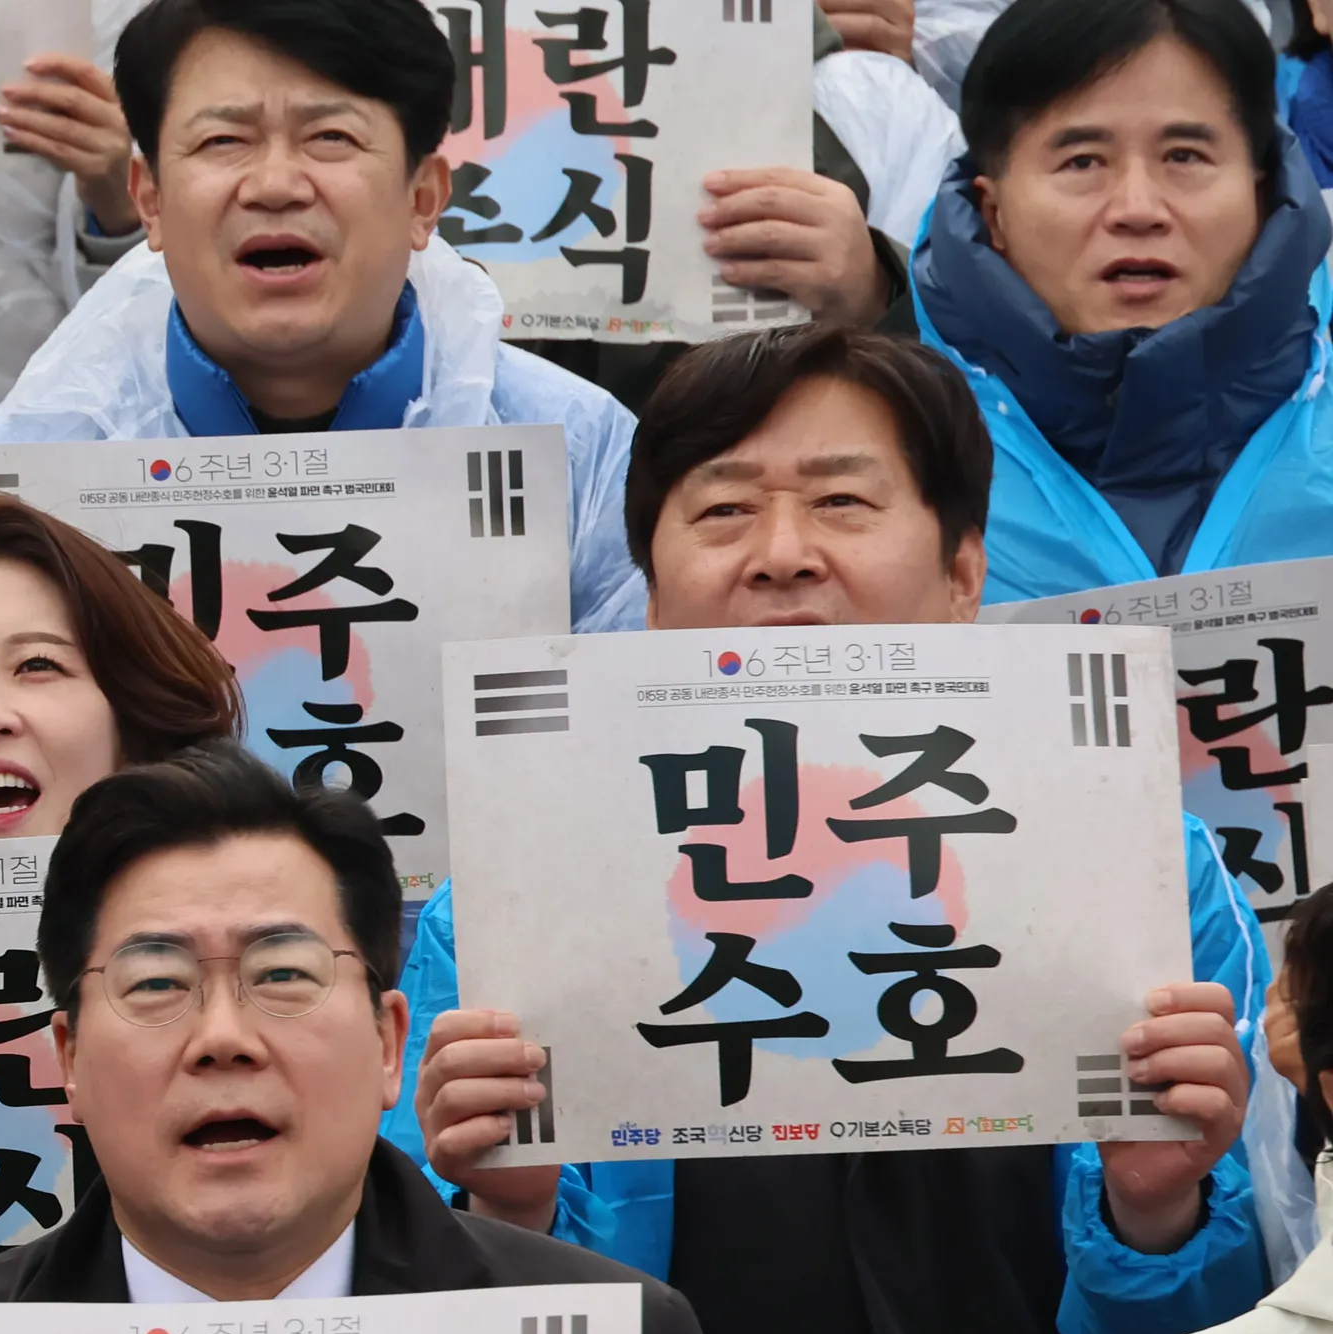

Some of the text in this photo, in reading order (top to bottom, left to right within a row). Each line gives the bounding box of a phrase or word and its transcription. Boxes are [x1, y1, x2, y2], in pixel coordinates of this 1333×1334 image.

[638, 718, 1017, 903] 민주
[7, 895, 28, 908] 파면
[635, 921, 1024, 1107] 수호
[772, 1123, 819, 1141] 진보당
